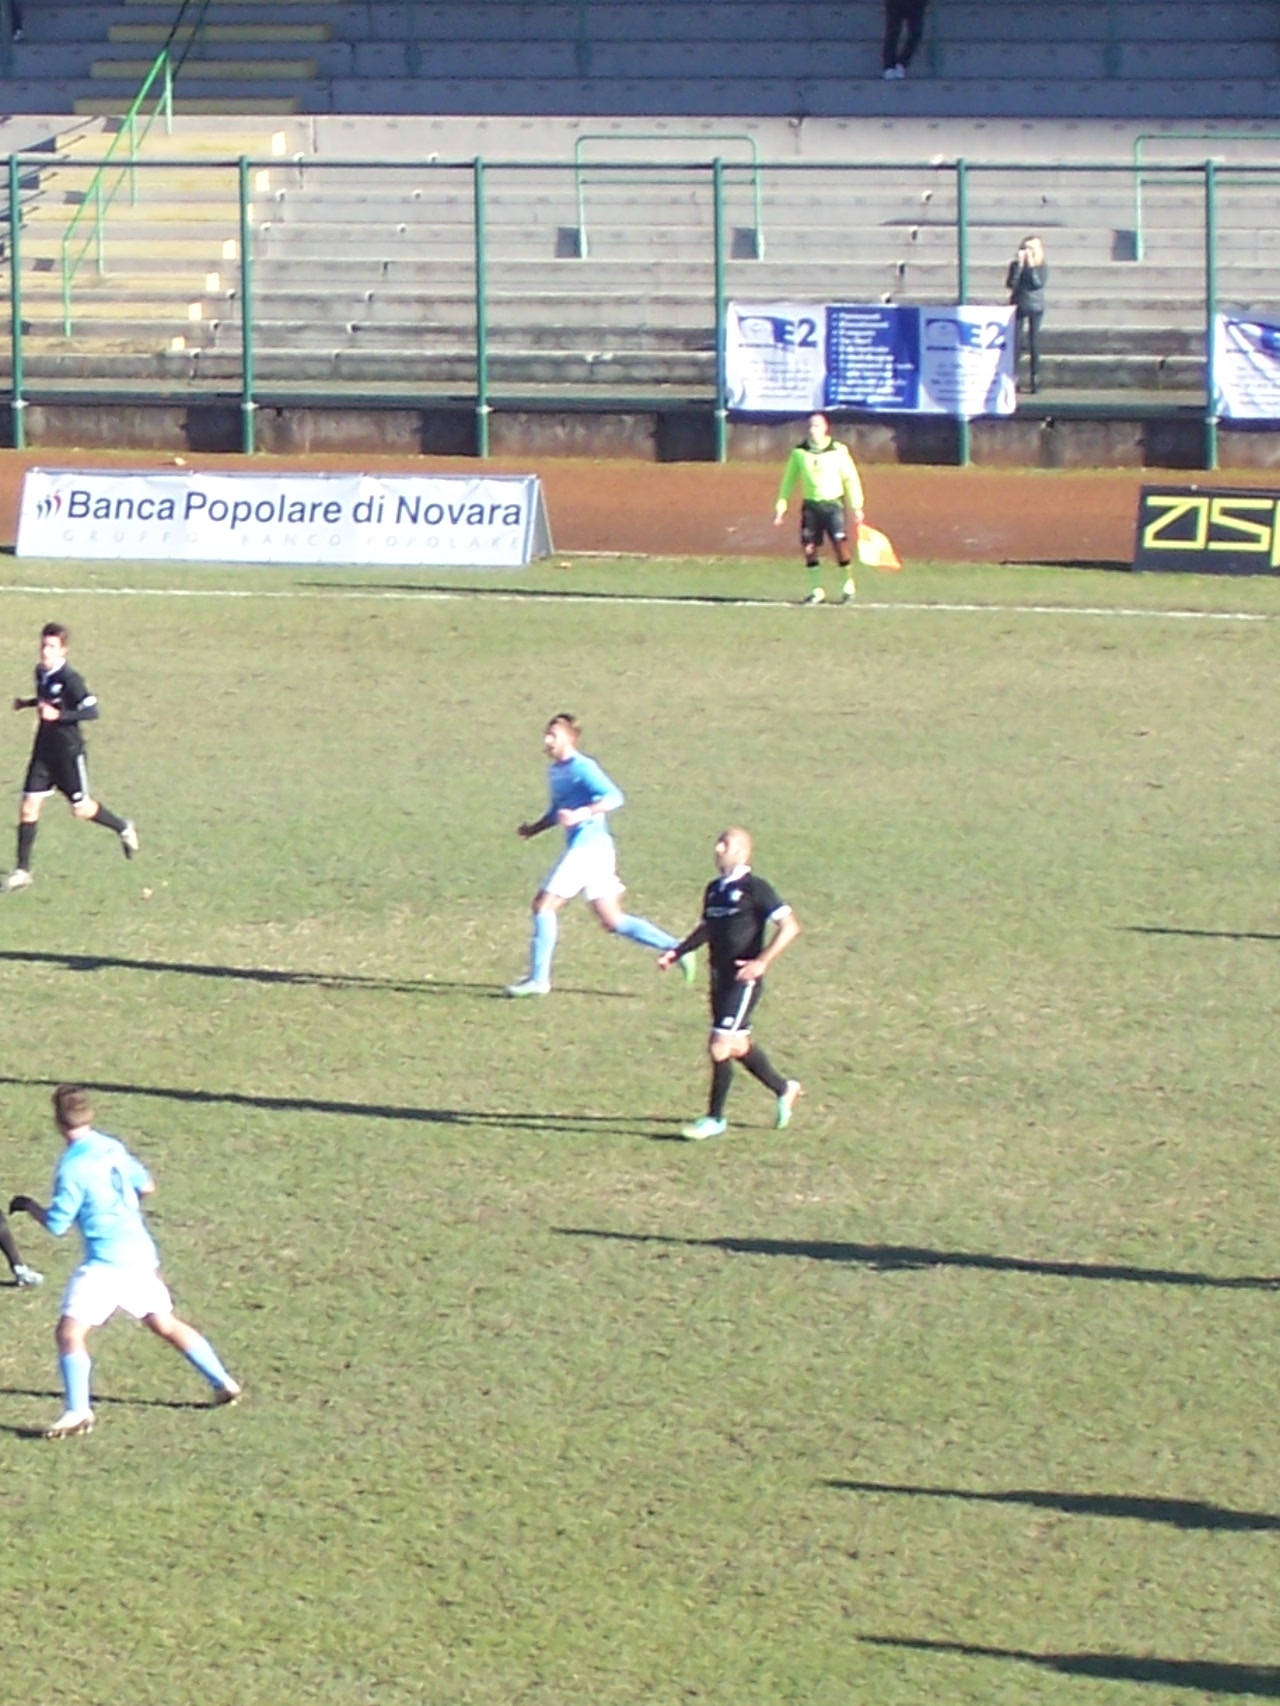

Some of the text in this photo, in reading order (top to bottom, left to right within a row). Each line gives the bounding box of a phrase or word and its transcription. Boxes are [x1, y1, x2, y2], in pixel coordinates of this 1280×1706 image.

[67, 489, 521, 530] Banca Popolare di Novara
[63, 529, 520, 550] GRUPPO BANCO POPOLARE
